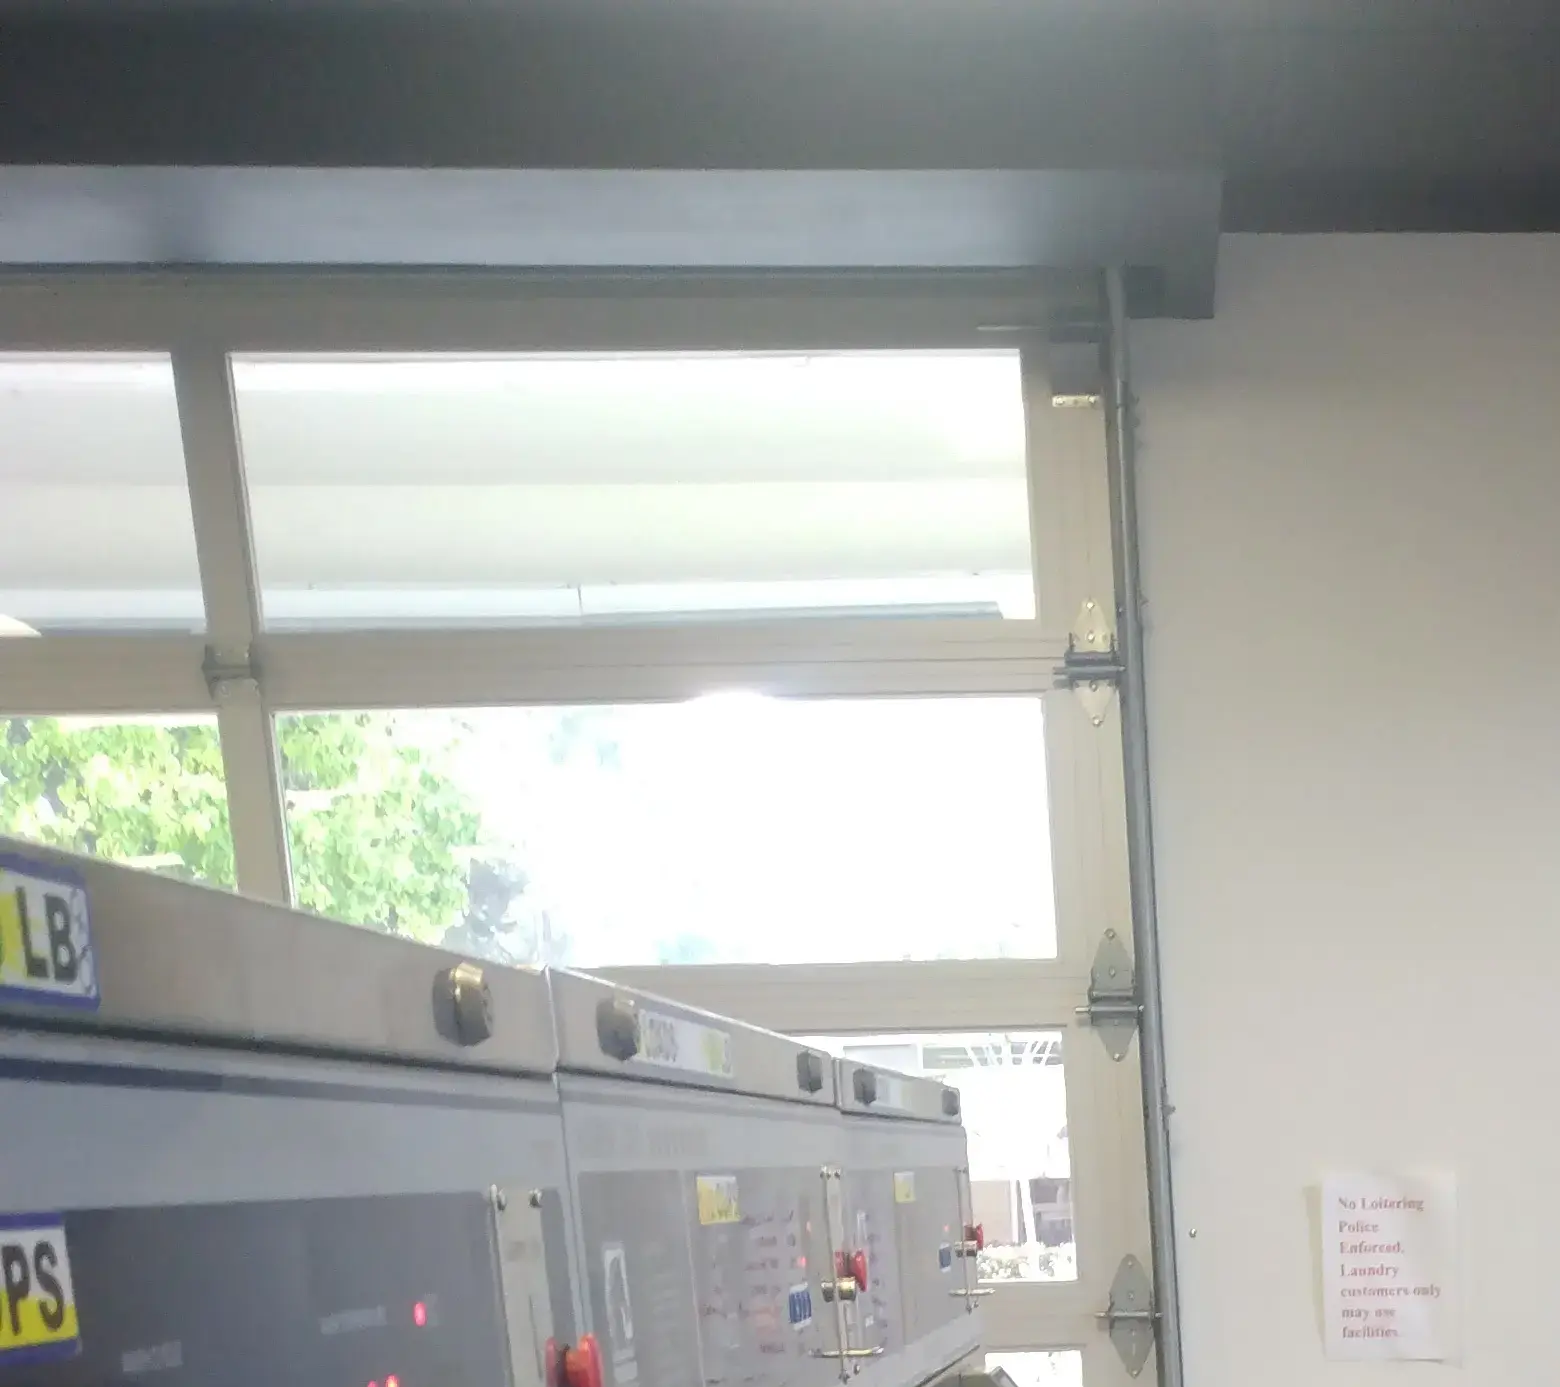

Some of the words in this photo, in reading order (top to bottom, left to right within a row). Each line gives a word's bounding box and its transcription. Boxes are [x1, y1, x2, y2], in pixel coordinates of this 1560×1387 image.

[1338, 1197, 1356, 1211] No
[1338, 1220, 1379, 1234] Police
[1340, 1264, 1400, 1279] Laundry
[0, 1240, 64, 1336] PS
[1340, 1285, 1409, 1298] customers
[1413, 1284, 1442, 1299] only
[1341, 1308, 1370, 1321] may
